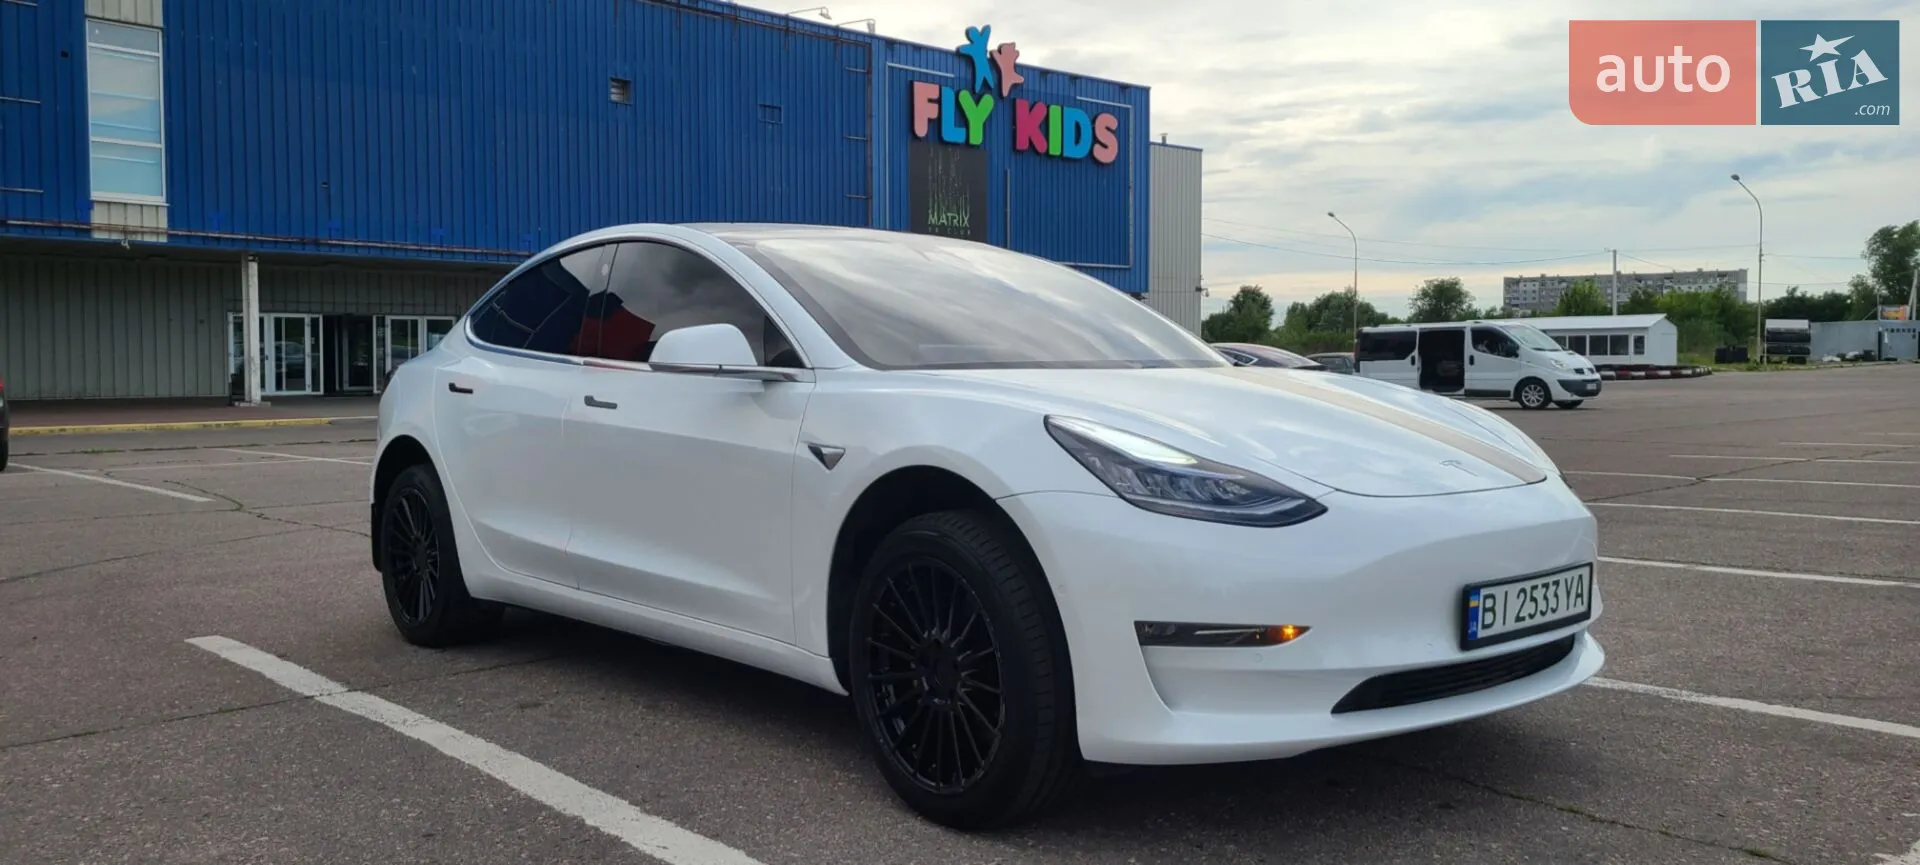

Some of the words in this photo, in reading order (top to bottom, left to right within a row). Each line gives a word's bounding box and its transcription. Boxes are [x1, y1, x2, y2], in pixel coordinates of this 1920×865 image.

[912, 82, 994, 145] FLY
[1015, 99, 1118, 163] KIDS
[928, 212, 970, 227] MATRIX
[1481, 592, 1508, 629] BI
[1515, 579, 1560, 622] 2533
[1565, 574, 1584, 610] YA
